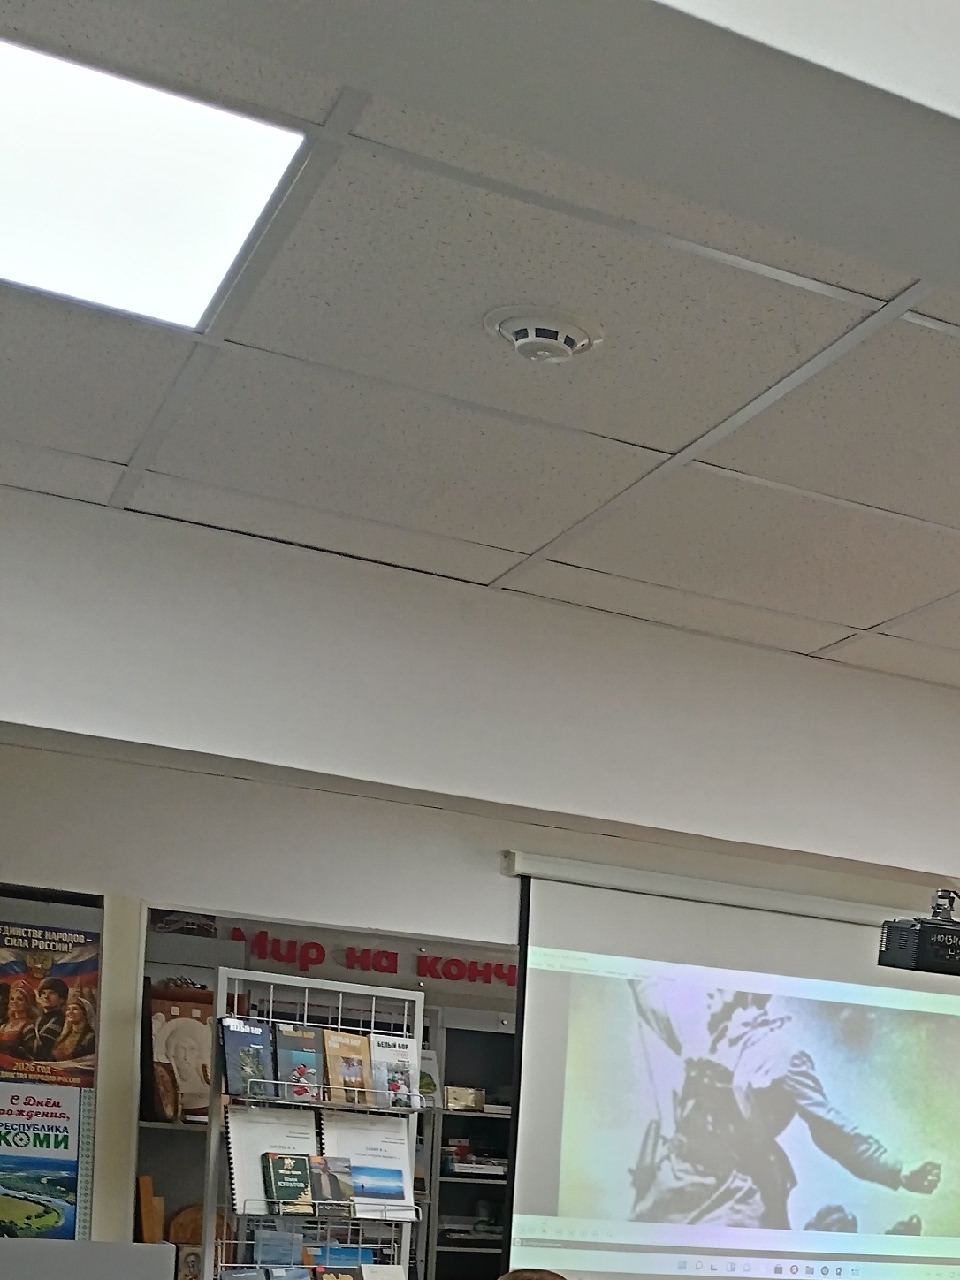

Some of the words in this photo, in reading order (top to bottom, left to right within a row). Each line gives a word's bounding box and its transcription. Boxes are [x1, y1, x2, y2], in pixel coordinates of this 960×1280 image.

[4, 936, 29, 949] СИЛА
[44, 930, 85, 943] НАРОДОВ
[231, 927, 325, 971] Мир
[345, 946, 398, 974] на
[416, 955, 516, 987] конч
[10, 1094, 20, 1106] С
[0, 1122, 69, 1134] РЕСПУБЛИКА
[0, 1131, 69, 1150] КОМИ
